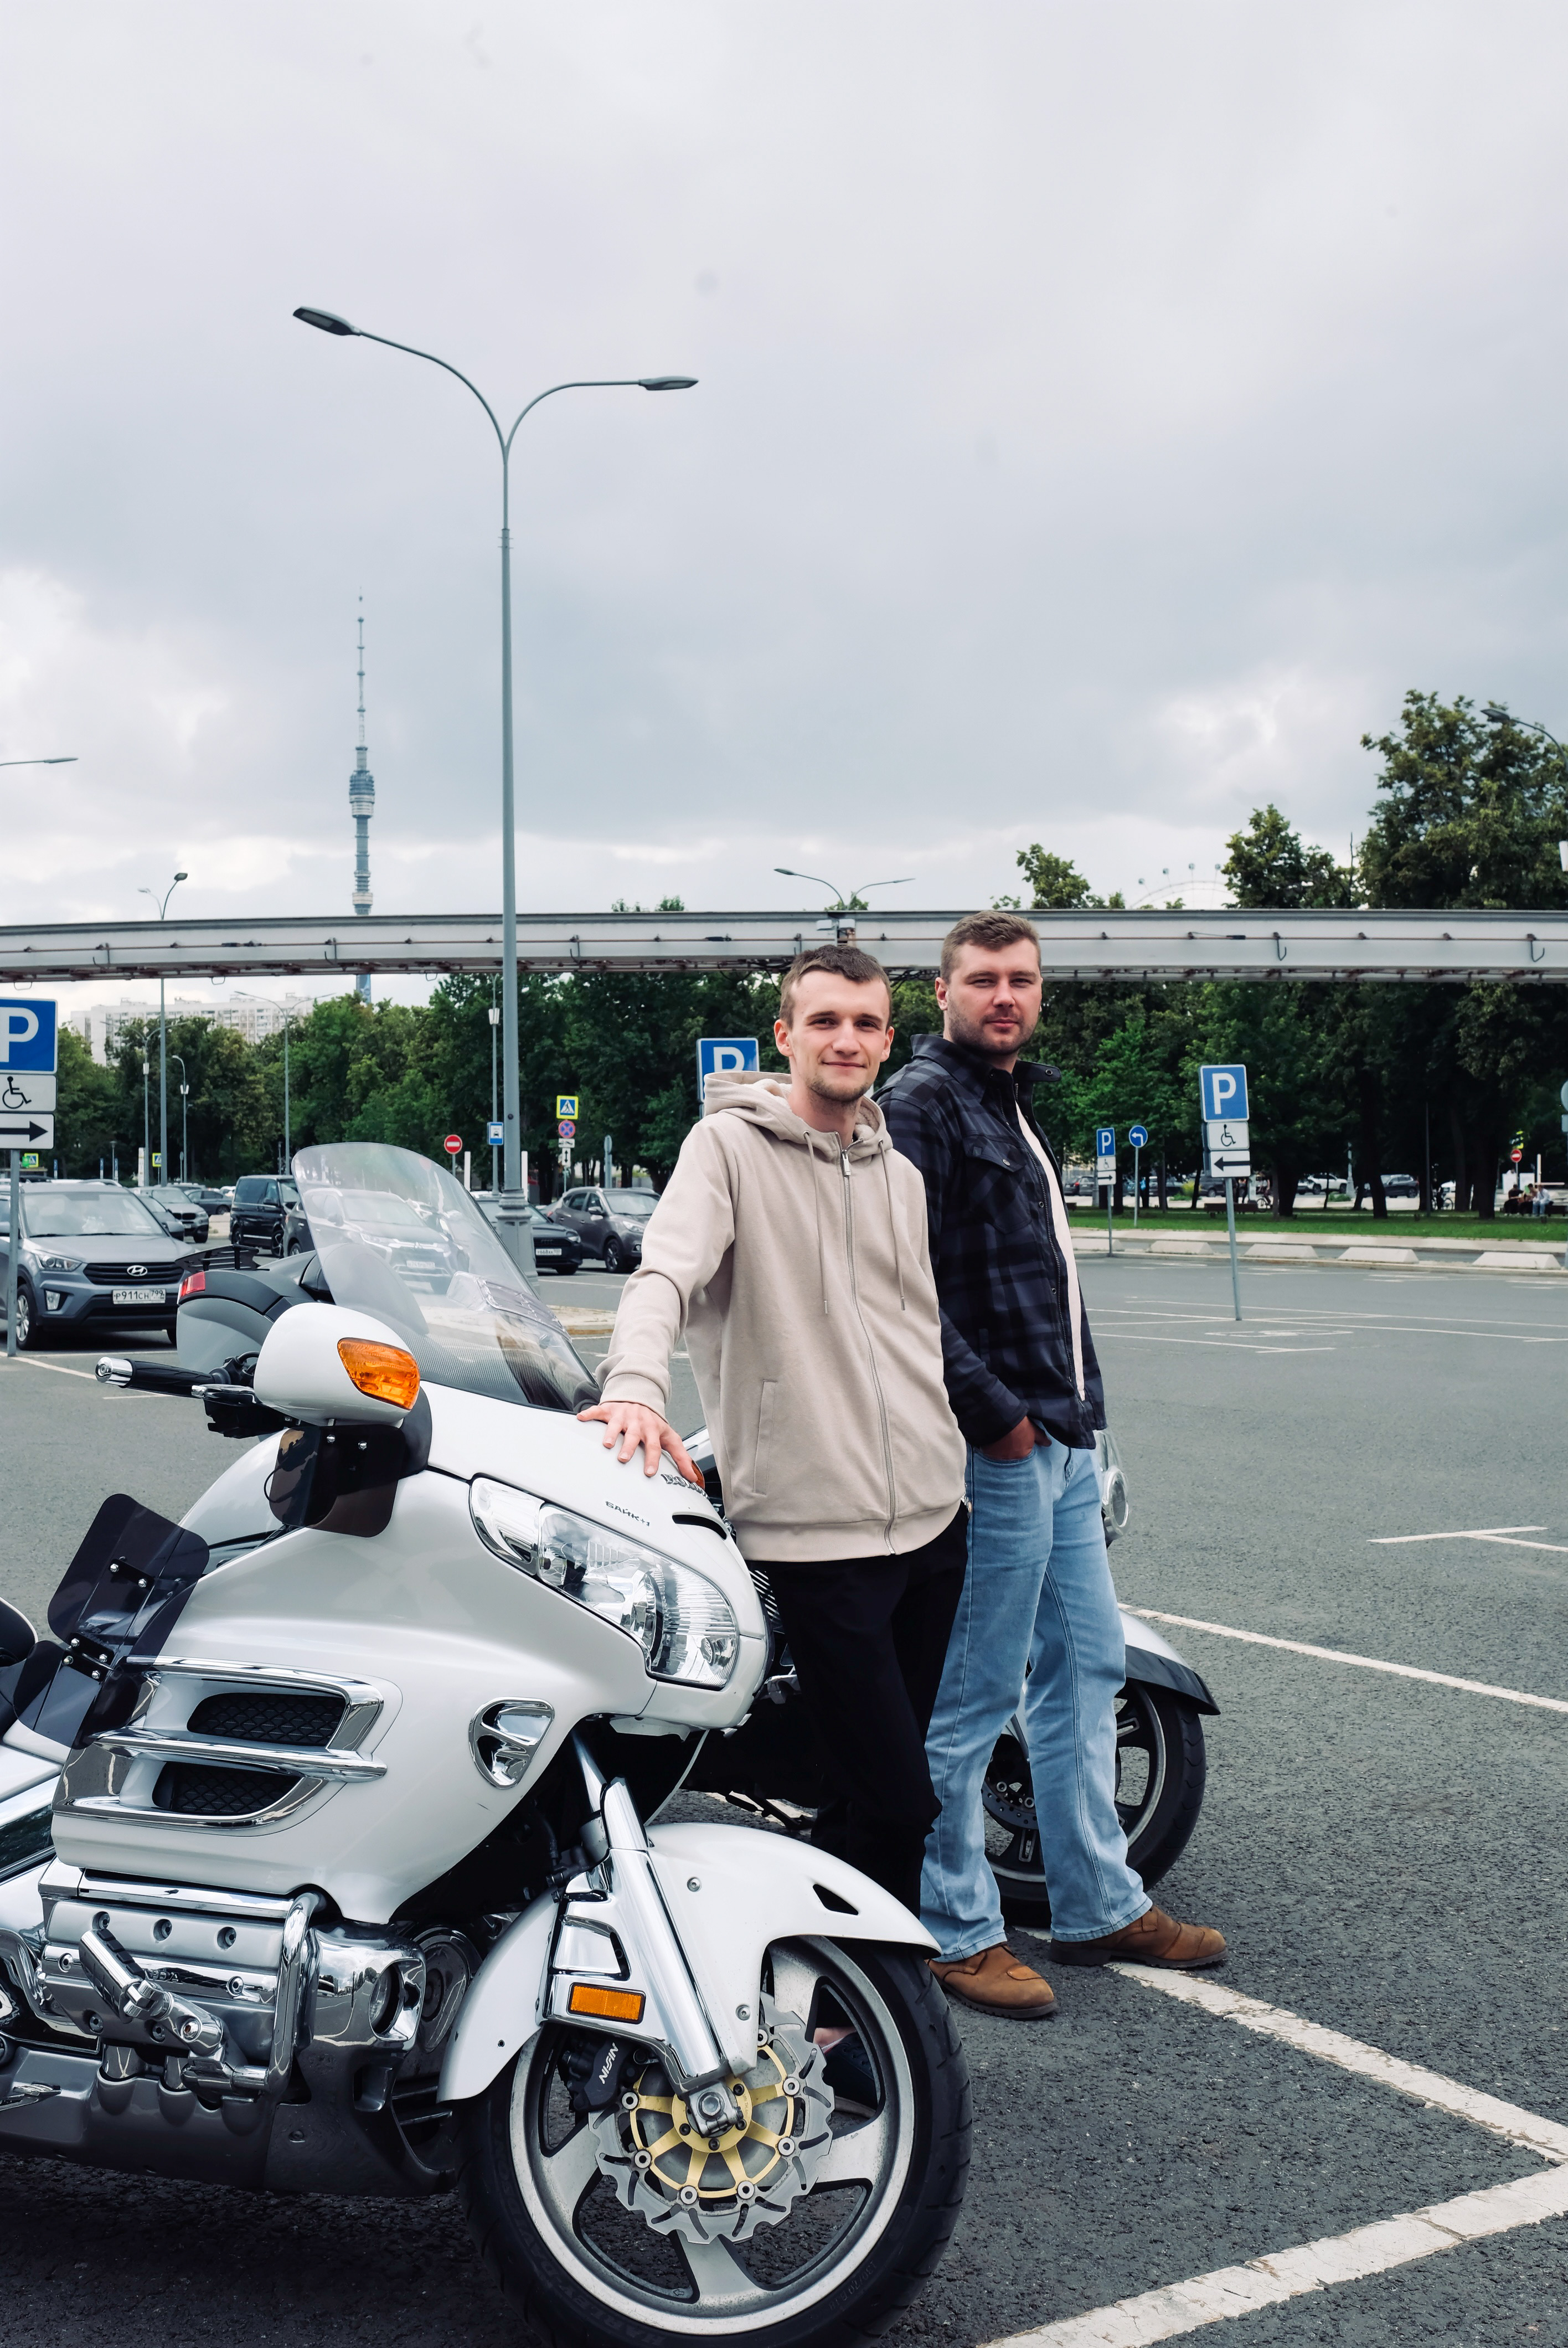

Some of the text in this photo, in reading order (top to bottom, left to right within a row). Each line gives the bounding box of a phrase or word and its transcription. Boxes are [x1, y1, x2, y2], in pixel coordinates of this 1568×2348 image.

[0, 1006, 39, 1062] P
[713, 1047, 745, 1073] P
[1212, 1073, 1236, 1115] P
[1101, 1131, 1112, 1154] P
